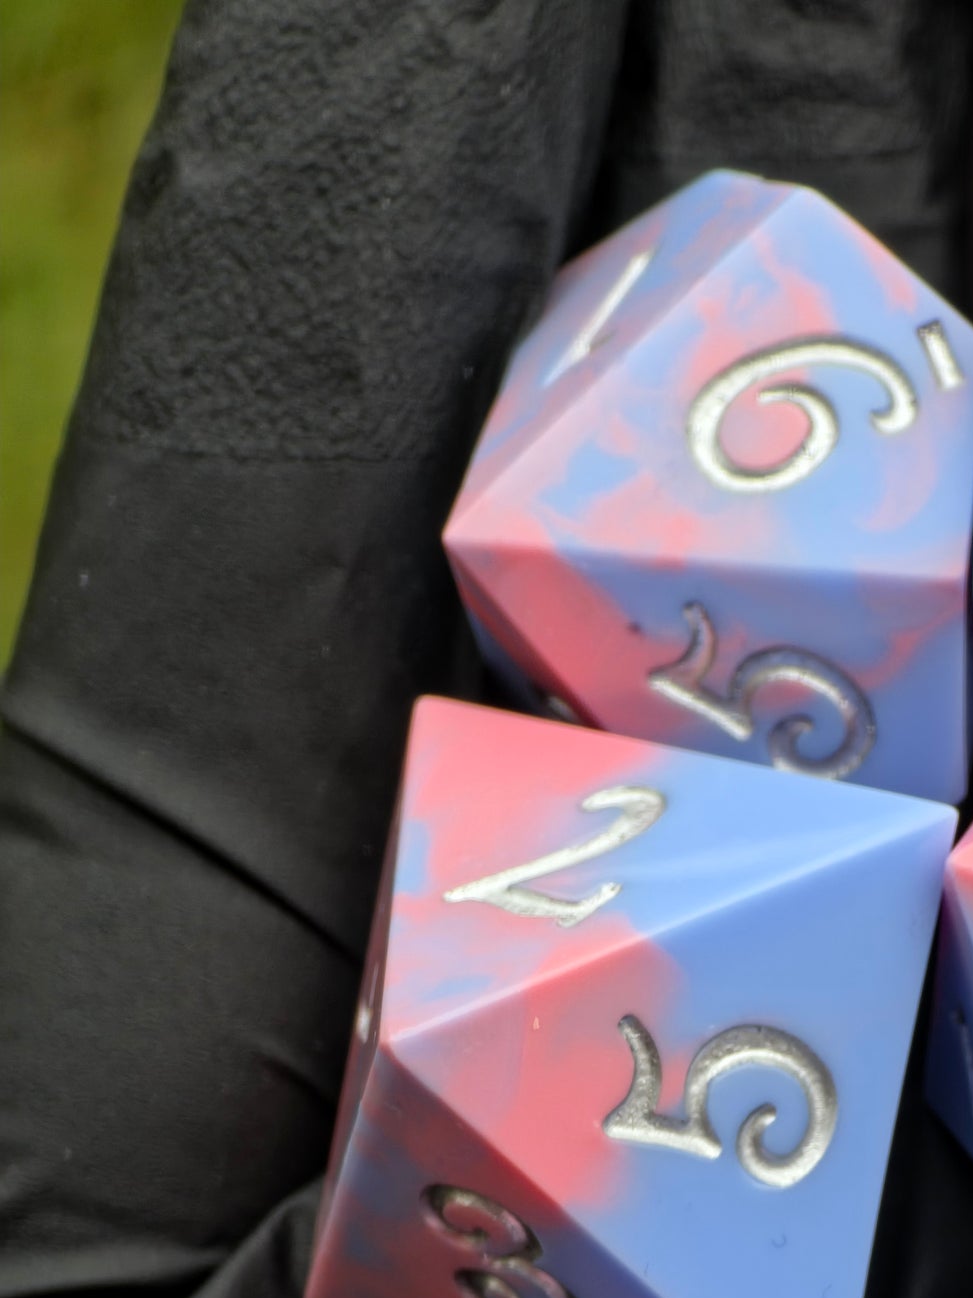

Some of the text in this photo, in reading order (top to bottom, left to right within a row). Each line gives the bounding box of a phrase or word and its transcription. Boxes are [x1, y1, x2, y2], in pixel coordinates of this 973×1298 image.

[648, 601, 880, 780] 5
[443, 785, 668, 928] 2
[604, 1012, 838, 1189] 5
